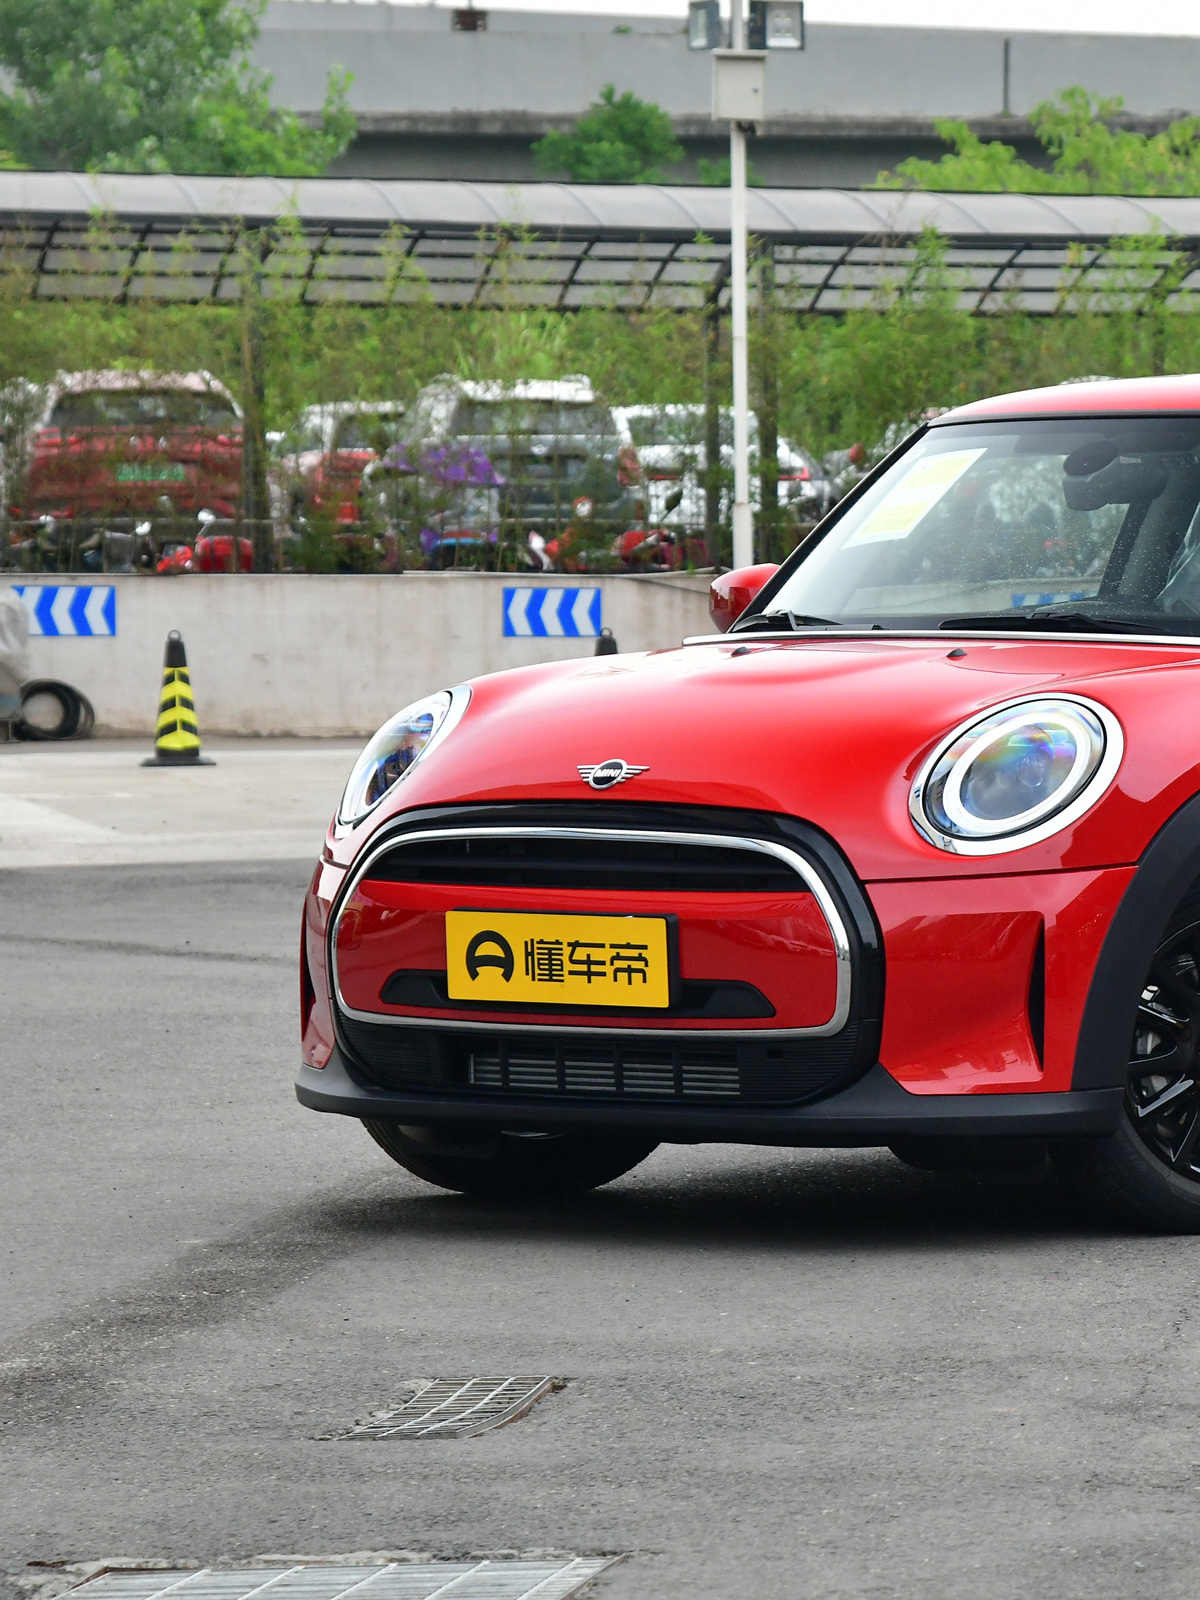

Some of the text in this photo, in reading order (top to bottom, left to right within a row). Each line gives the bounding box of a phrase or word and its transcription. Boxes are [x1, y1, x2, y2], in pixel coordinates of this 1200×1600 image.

[594, 768, 622, 778] MINI
[523, 938, 649, 985] 懂车帝
